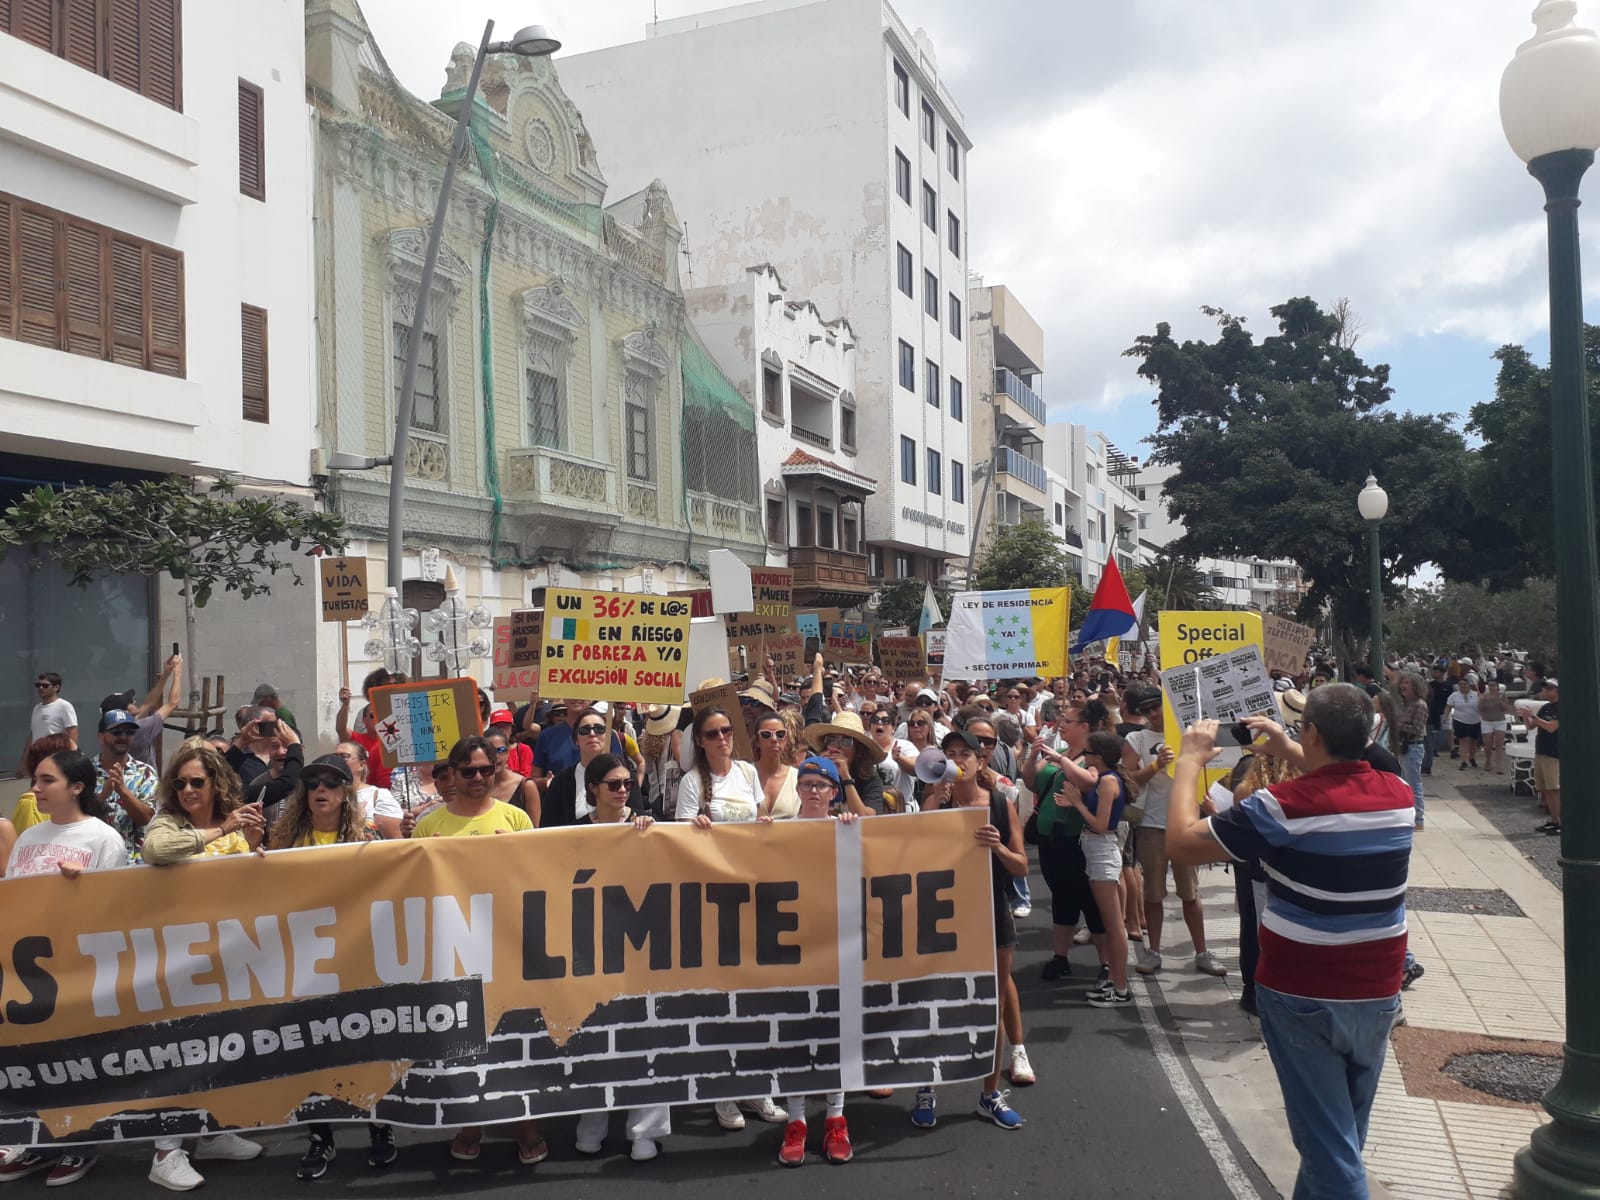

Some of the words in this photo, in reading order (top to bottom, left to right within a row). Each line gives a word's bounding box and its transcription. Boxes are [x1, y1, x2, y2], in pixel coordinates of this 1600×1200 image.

[326, 575, 362, 587] VIDA
[760, 587, 790, 602] MUERE
[323, 599, 369, 611] TURISTAS
[557, 595, 582, 610] UN
[593, 595, 635, 618] 36%
[641, 602, 654, 615] DE
[661, 601, 688, 616] L@S
[998, 599, 1053, 608] RESIDENCIA
[599, 627, 621, 641] EN
[632, 624, 683, 642] RIESGO
[1177, 623, 1245, 644] Special
[546, 645, 564, 658] DE
[573, 644, 647, 662] POBREZA
[657, 647, 681, 661] Y/O
[1183, 648, 1221, 664] Off
[634, 671, 682, 688] SOCIAL
[0, 936, 58, 1025] S
[77, 906, 340, 1017] TIENE
[370, 893, 494, 985] UN
[522, 869, 801, 980] LÍMITE
[38, 1057, 97, 1084] UN
[101, 1032, 245, 1076] CAMBIO
[253, 1024, 304, 1055] DE
[309, 1000, 468, 1046] MODELO!
